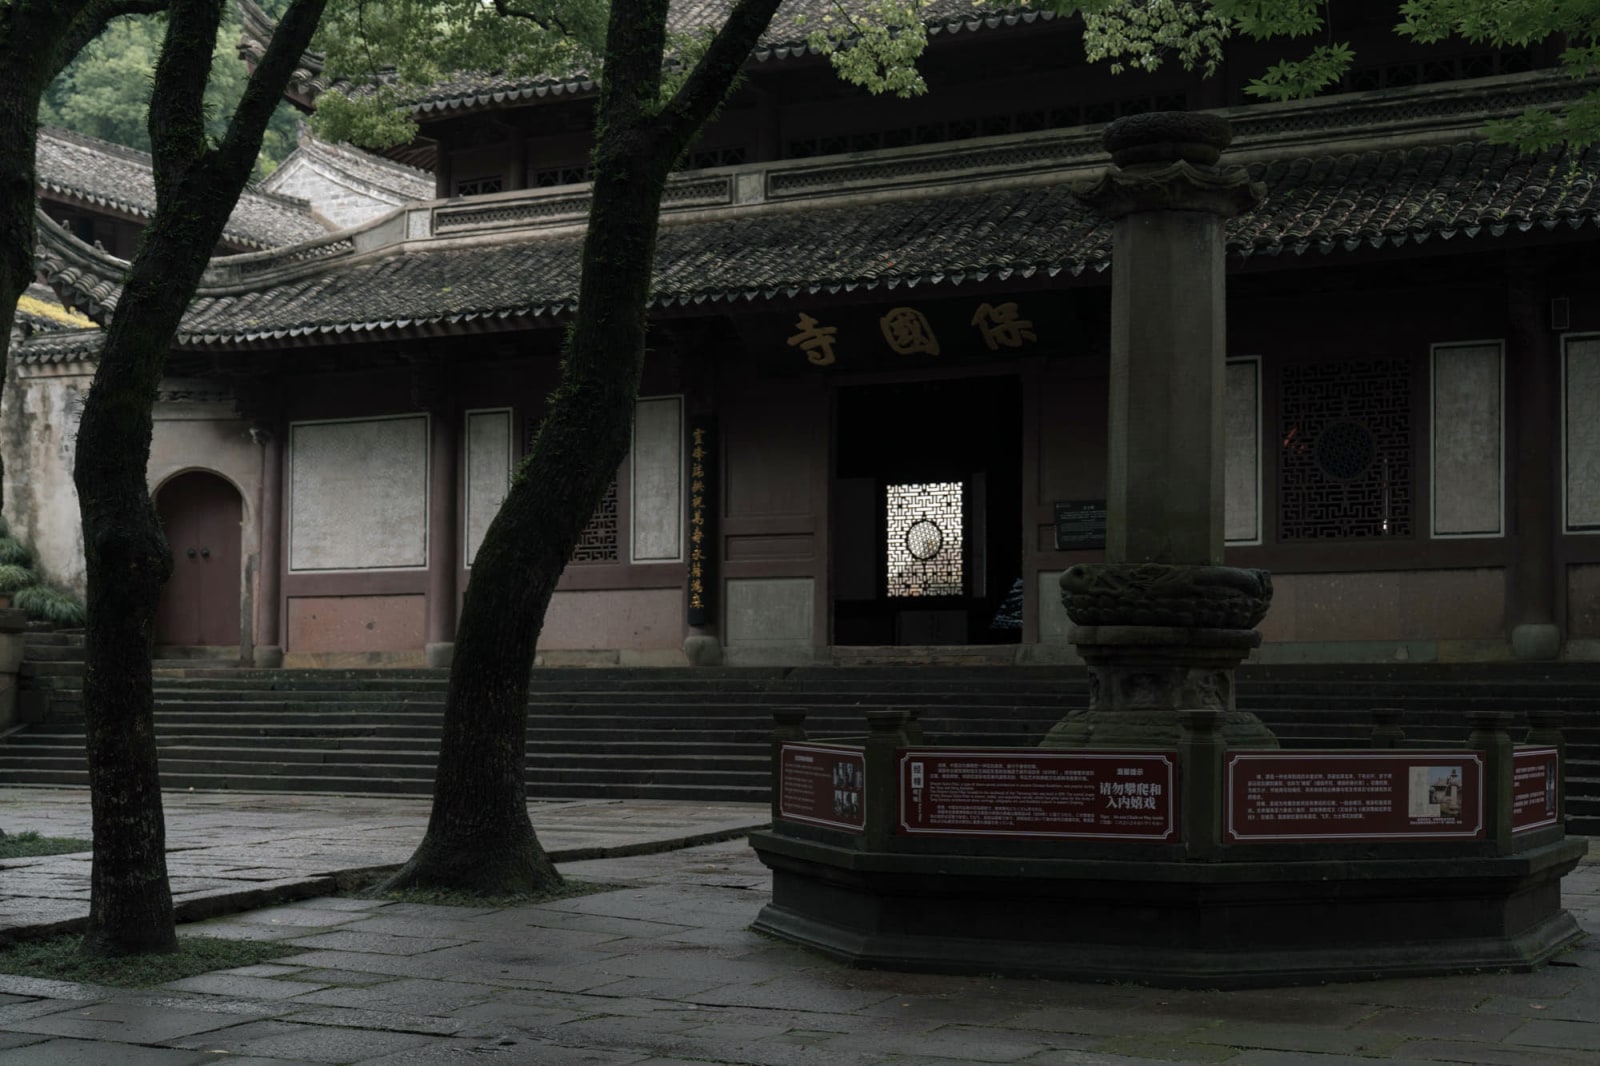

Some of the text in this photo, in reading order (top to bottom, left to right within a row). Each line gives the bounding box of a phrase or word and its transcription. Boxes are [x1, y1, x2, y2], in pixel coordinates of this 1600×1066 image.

[1099, 782, 1162, 796] 请勿攀爬和
[1105, 796, 1156, 810] 入内嬉戏
